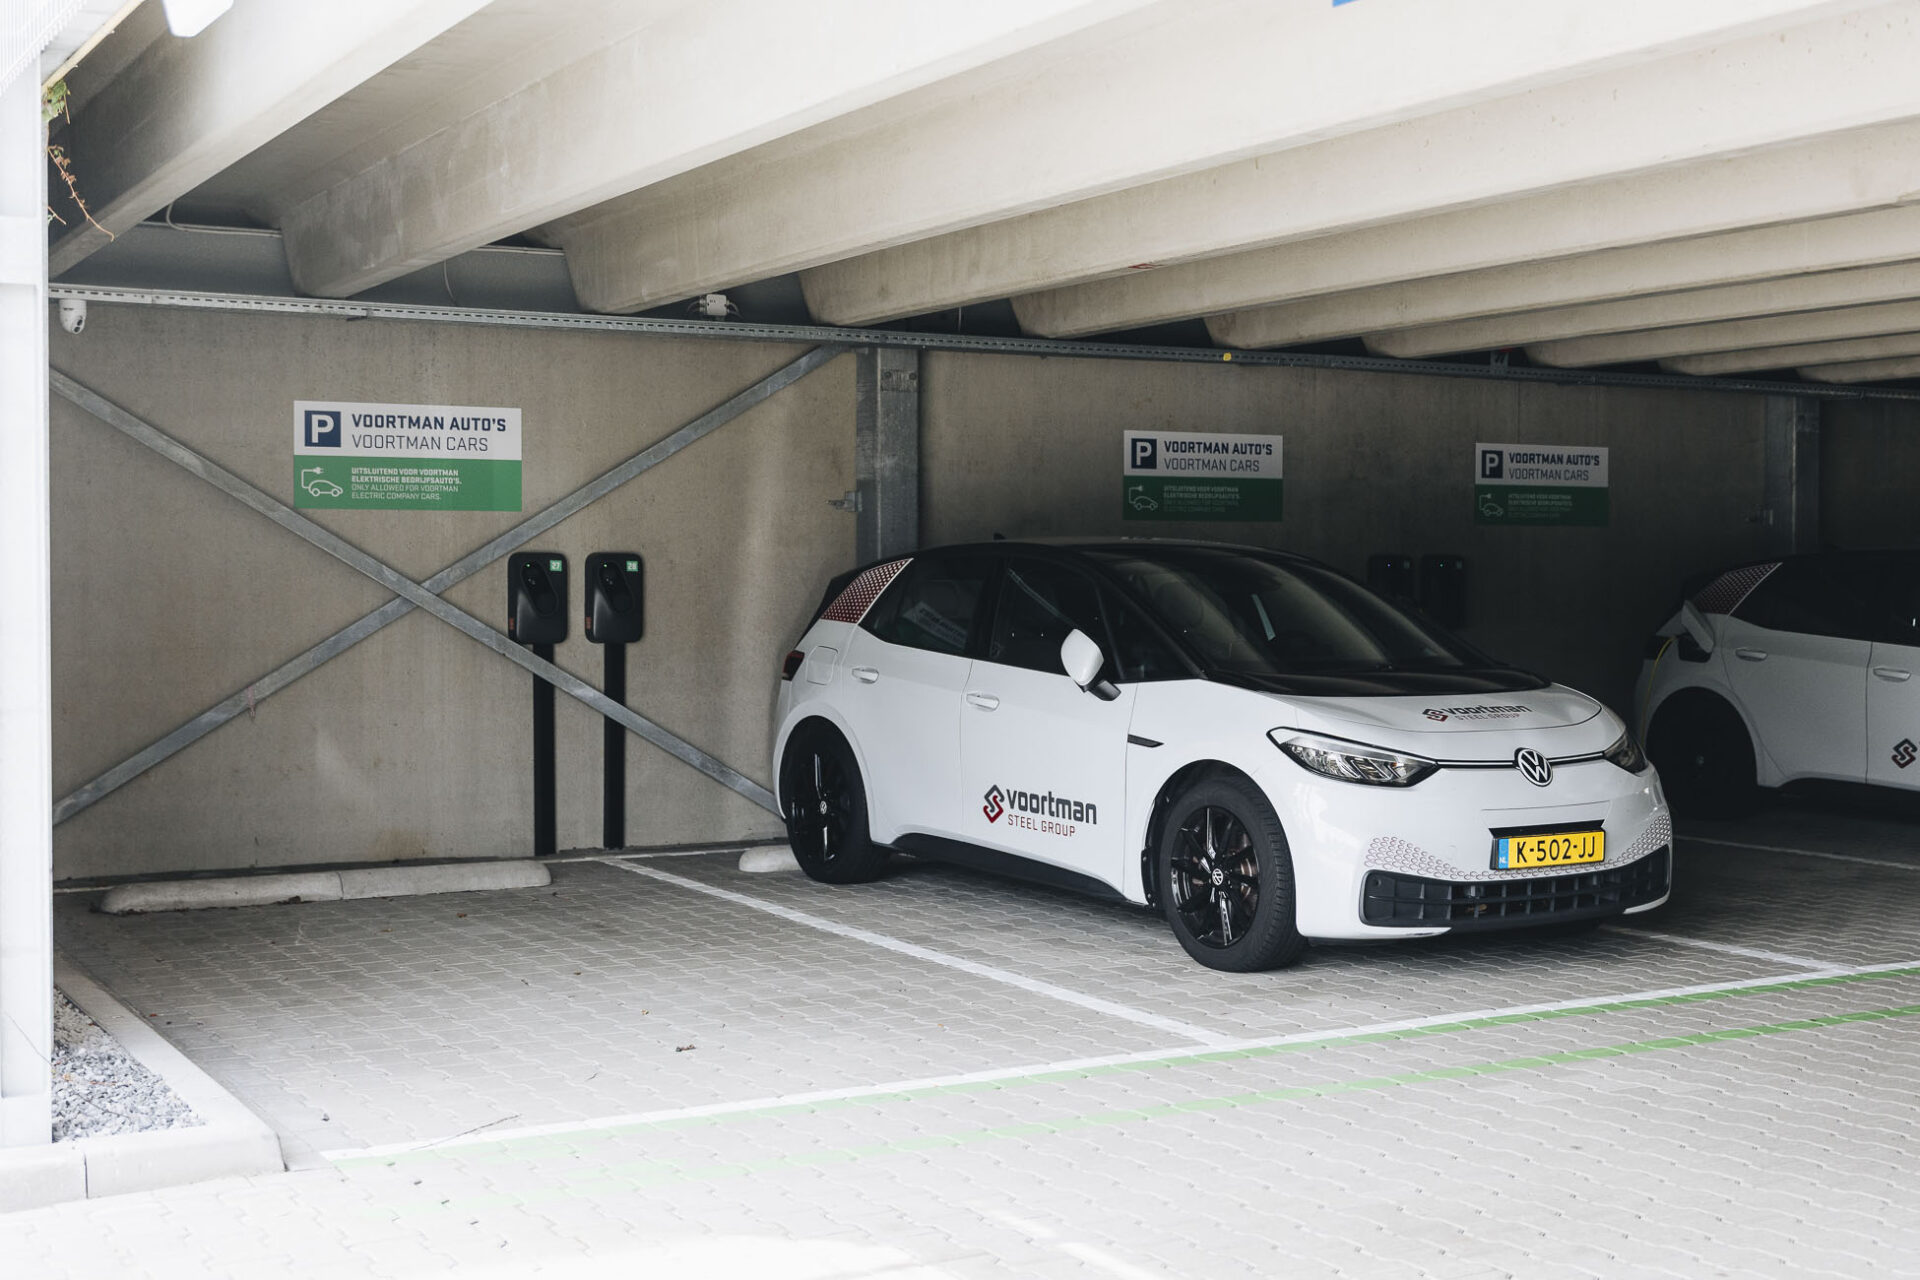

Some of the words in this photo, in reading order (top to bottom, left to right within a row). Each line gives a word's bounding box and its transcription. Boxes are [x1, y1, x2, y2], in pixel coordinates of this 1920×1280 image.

[311, 414, 335, 443] P
[352, 413, 445, 431] VOORTMAN
[449, 416, 507, 432] AUTO'S
[352, 434, 441, 450] VOORTMAN
[446, 436, 489, 452] CARS
[1164, 440, 1229, 455] VOORTMAN
[1232, 443, 1273, 456] AUTO'S
[1136, 441, 1153, 466] P
[1508, 452, 1563, 465] VOORTMAN
[1565, 454, 1600, 466] AUTO'S
[351, 467, 398, 475] UITSLUITEND
[399, 468, 418, 476] VOOR
[419, 468, 459, 477] VOORTMAN
[1164, 457, 1227, 471] VOORTMAN
[1230, 459, 1260, 472] CARS
[1485, 453, 1499, 476] P
[351, 475, 399, 483] ELEKTRISCHE
[1508, 468, 1561, 480] VOORTMAN
[1563, 469, 1589, 481] CARS
[351, 483, 369, 491] ONLY
[370, 484, 404, 492] ALLOWED
[405, 484, 419, 492] FOR
[420, 485, 459, 493] VOORTMAN
[351, 491, 385, 499] ELECTRIC
[386, 492, 420, 500] COMPANY
[1441, 704, 1533, 715] voortman
[1006, 788, 1097, 825] voortman
[1007, 813, 1038, 831] STEEL
[1041, 820, 1076, 837] GROUP
[1516, 836, 1596, 863] K-502-JJ
